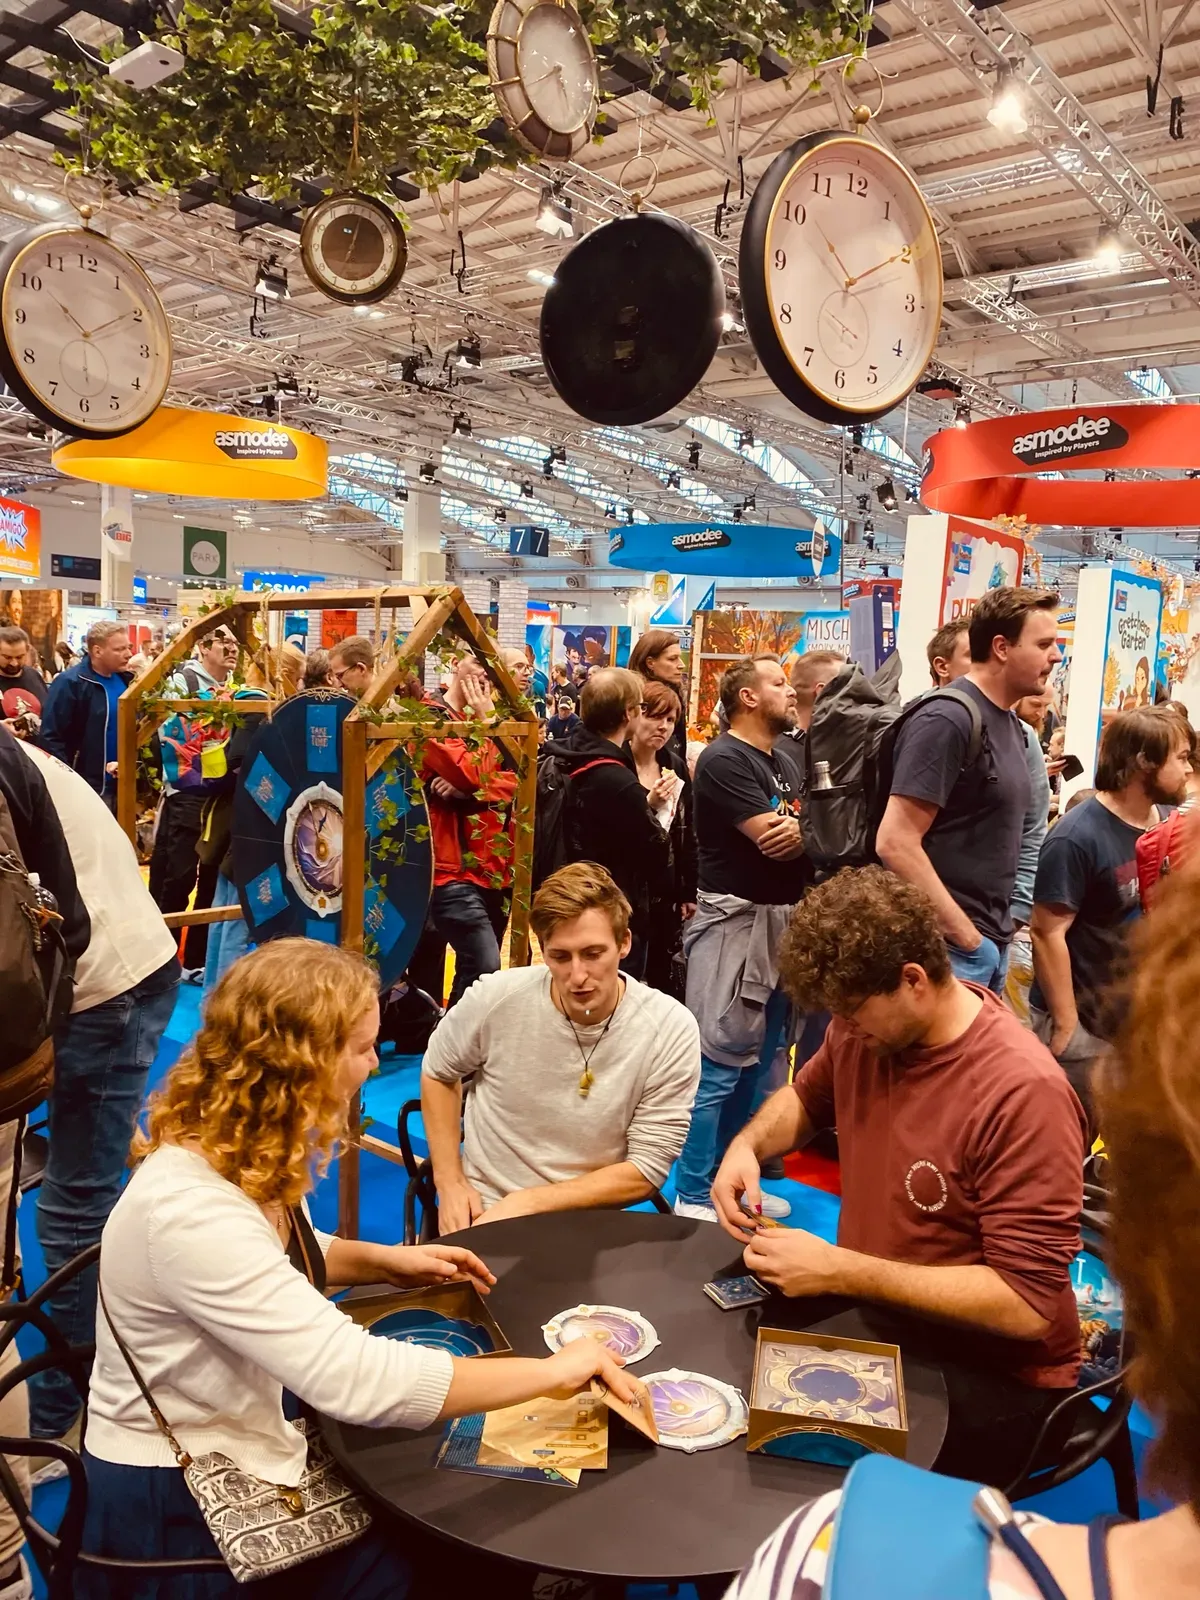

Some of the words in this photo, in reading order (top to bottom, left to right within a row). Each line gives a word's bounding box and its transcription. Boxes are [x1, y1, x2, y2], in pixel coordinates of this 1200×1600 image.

[811, 172, 833, 199] 11
[846, 173, 869, 198] 12
[782, 200, 806, 225] 10
[883, 202, 891, 221] 1
[45, 253, 64, 272] 11
[78, 254, 98, 273] 12
[775, 249, 787, 270] 9
[901, 244, 911, 264] 2
[20, 272, 42, 291] 10
[113, 276, 121, 290] 1
[905, 294, 915, 313] 3
[15, 309, 27, 324] 9
[133, 308, 142, 322] 2
[779, 303, 792, 324] 8
[23, 348, 35, 364] 8
[140, 344, 149, 358] 3
[804, 347, 814, 367] 7
[892, 339, 903, 357] 4
[131, 377, 141, 390] 4
[834, 369, 845, 389] 6
[867, 365, 878, 384] 5
[48, 381, 58, 396] 7
[79, 398, 90, 413] 6
[109, 396, 120, 411] 5
[215, 427, 289, 448] asmodee
[1012, 416, 1111, 454] asmodee
[1035, 448, 1062, 459] Inspired
[1063, 445, 1072, 453] by
[1073, 440, 1100, 451] Players
[0, 520, 21, 536] AMIGO
[116, 532, 132, 543] BIG
[672, 528, 723, 546] asmodee
[515, 529, 526, 552] 7
[535, 530, 545, 553] 7
[193, 551, 218, 564] PARK
[1121, 630, 1146, 651] Garten
